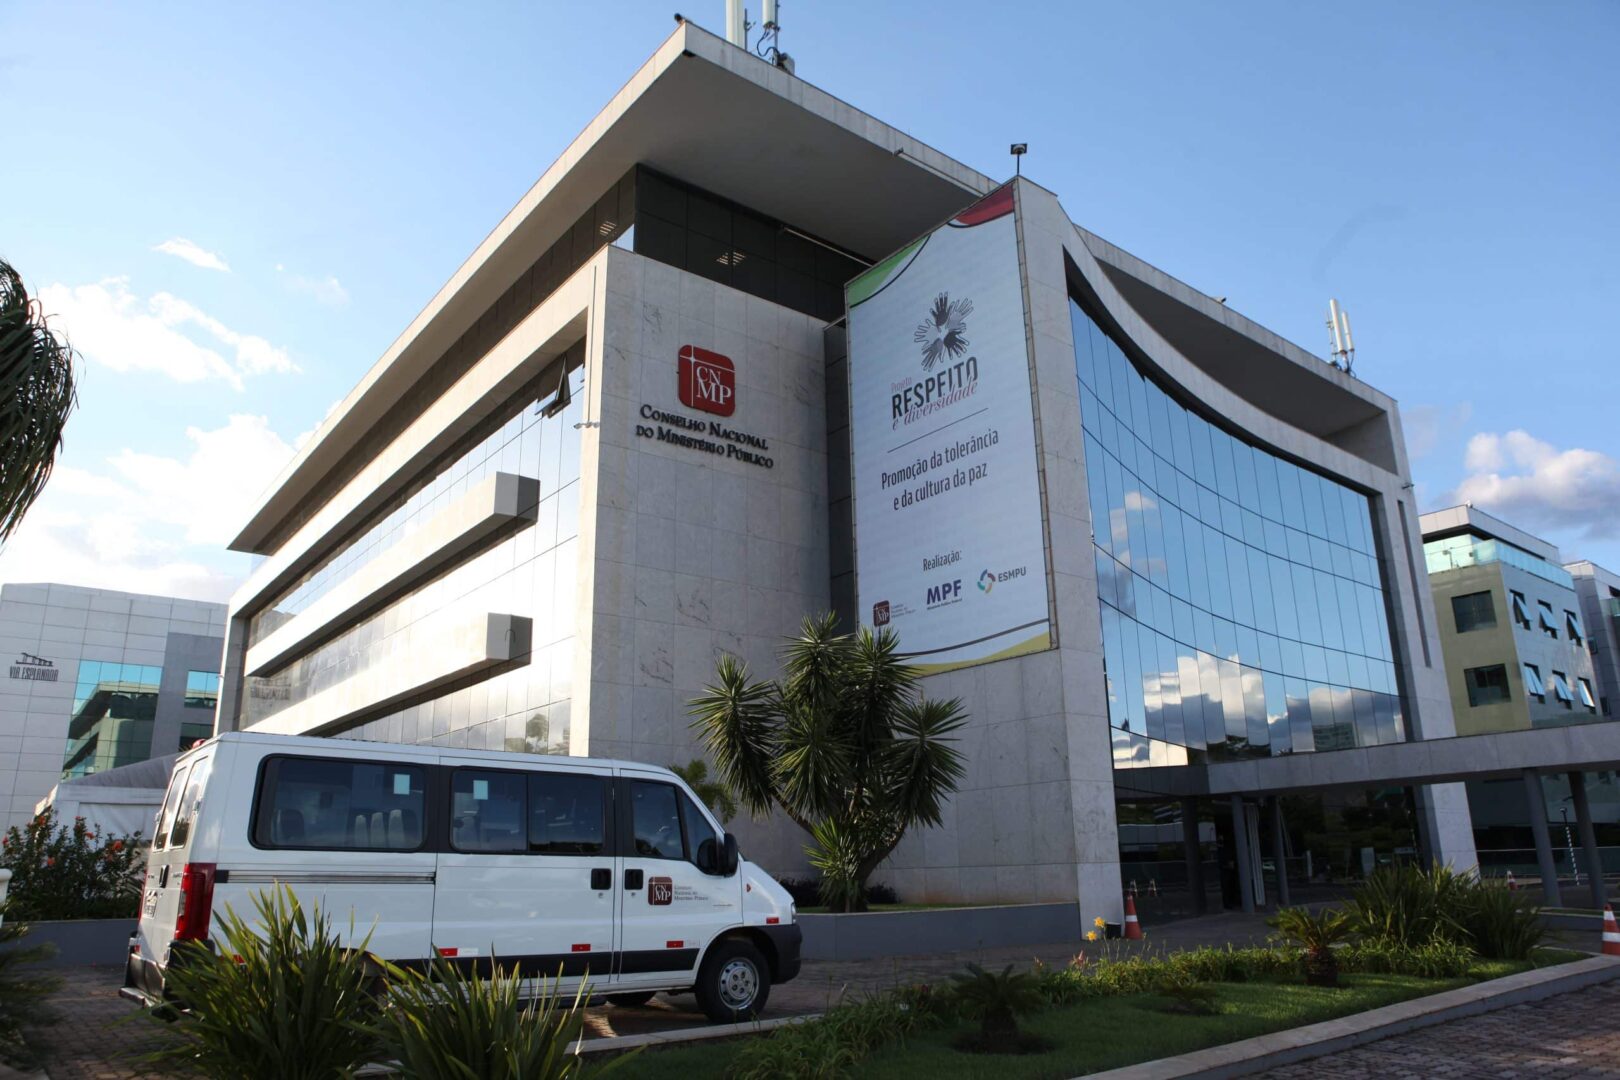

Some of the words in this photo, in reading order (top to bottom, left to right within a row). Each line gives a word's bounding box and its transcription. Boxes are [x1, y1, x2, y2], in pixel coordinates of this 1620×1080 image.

[891, 356, 978, 420] RESPEITO
[904, 375, 978, 426] diversidade
[639, 404, 706, 432] CONSELHO
[709, 421, 768, 450] NACIONAL
[881, 458, 928, 490] Promoção
[931, 450, 943, 469] da
[945, 428, 999, 464] tolerância
[893, 496, 900, 511] e
[901, 490, 913, 508] da
[915, 474, 951, 502] cultura
[953, 468, 966, 488] da
[969, 462, 988, 489] paz
[923, 550, 962, 571] Realização:
[998, 566, 1027, 583] ESMPU
[926, 579, 962, 605] MPF
